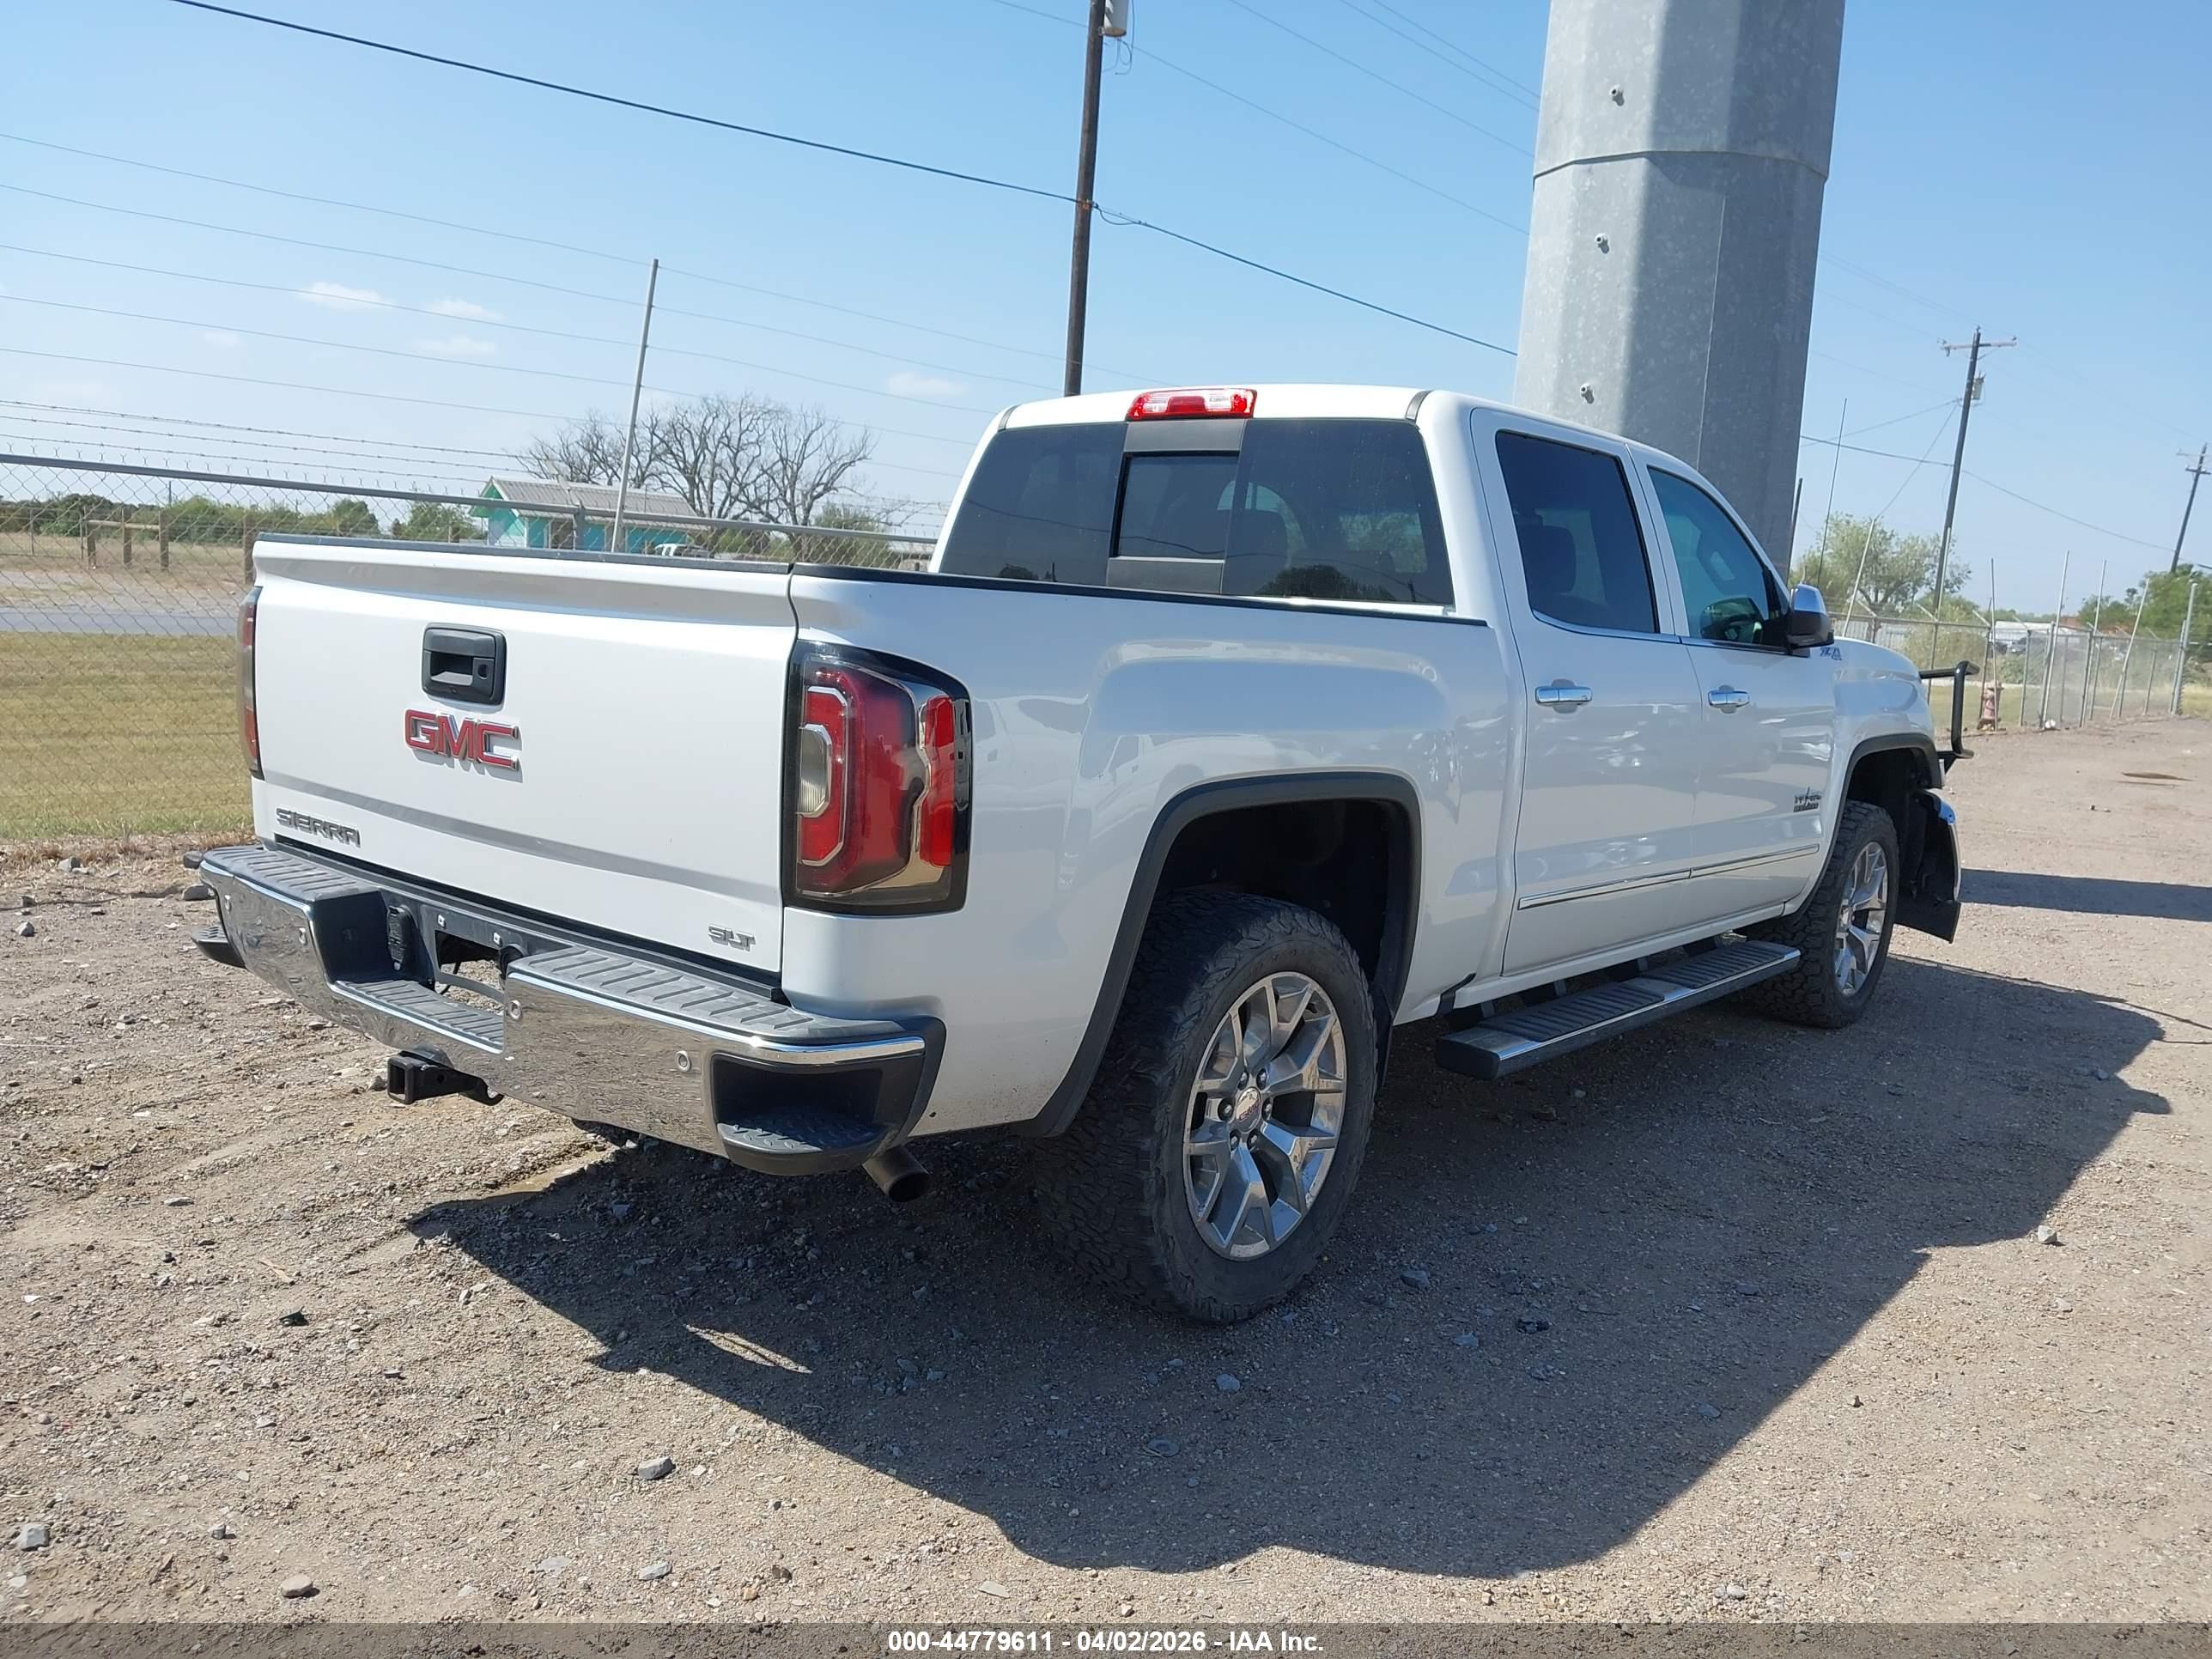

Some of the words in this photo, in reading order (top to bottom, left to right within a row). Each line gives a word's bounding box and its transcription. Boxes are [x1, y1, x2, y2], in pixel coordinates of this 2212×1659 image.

[404, 708, 520, 770] GMC
[276, 807, 361, 848] SIERRA
[708, 925, 757, 952] SLT
